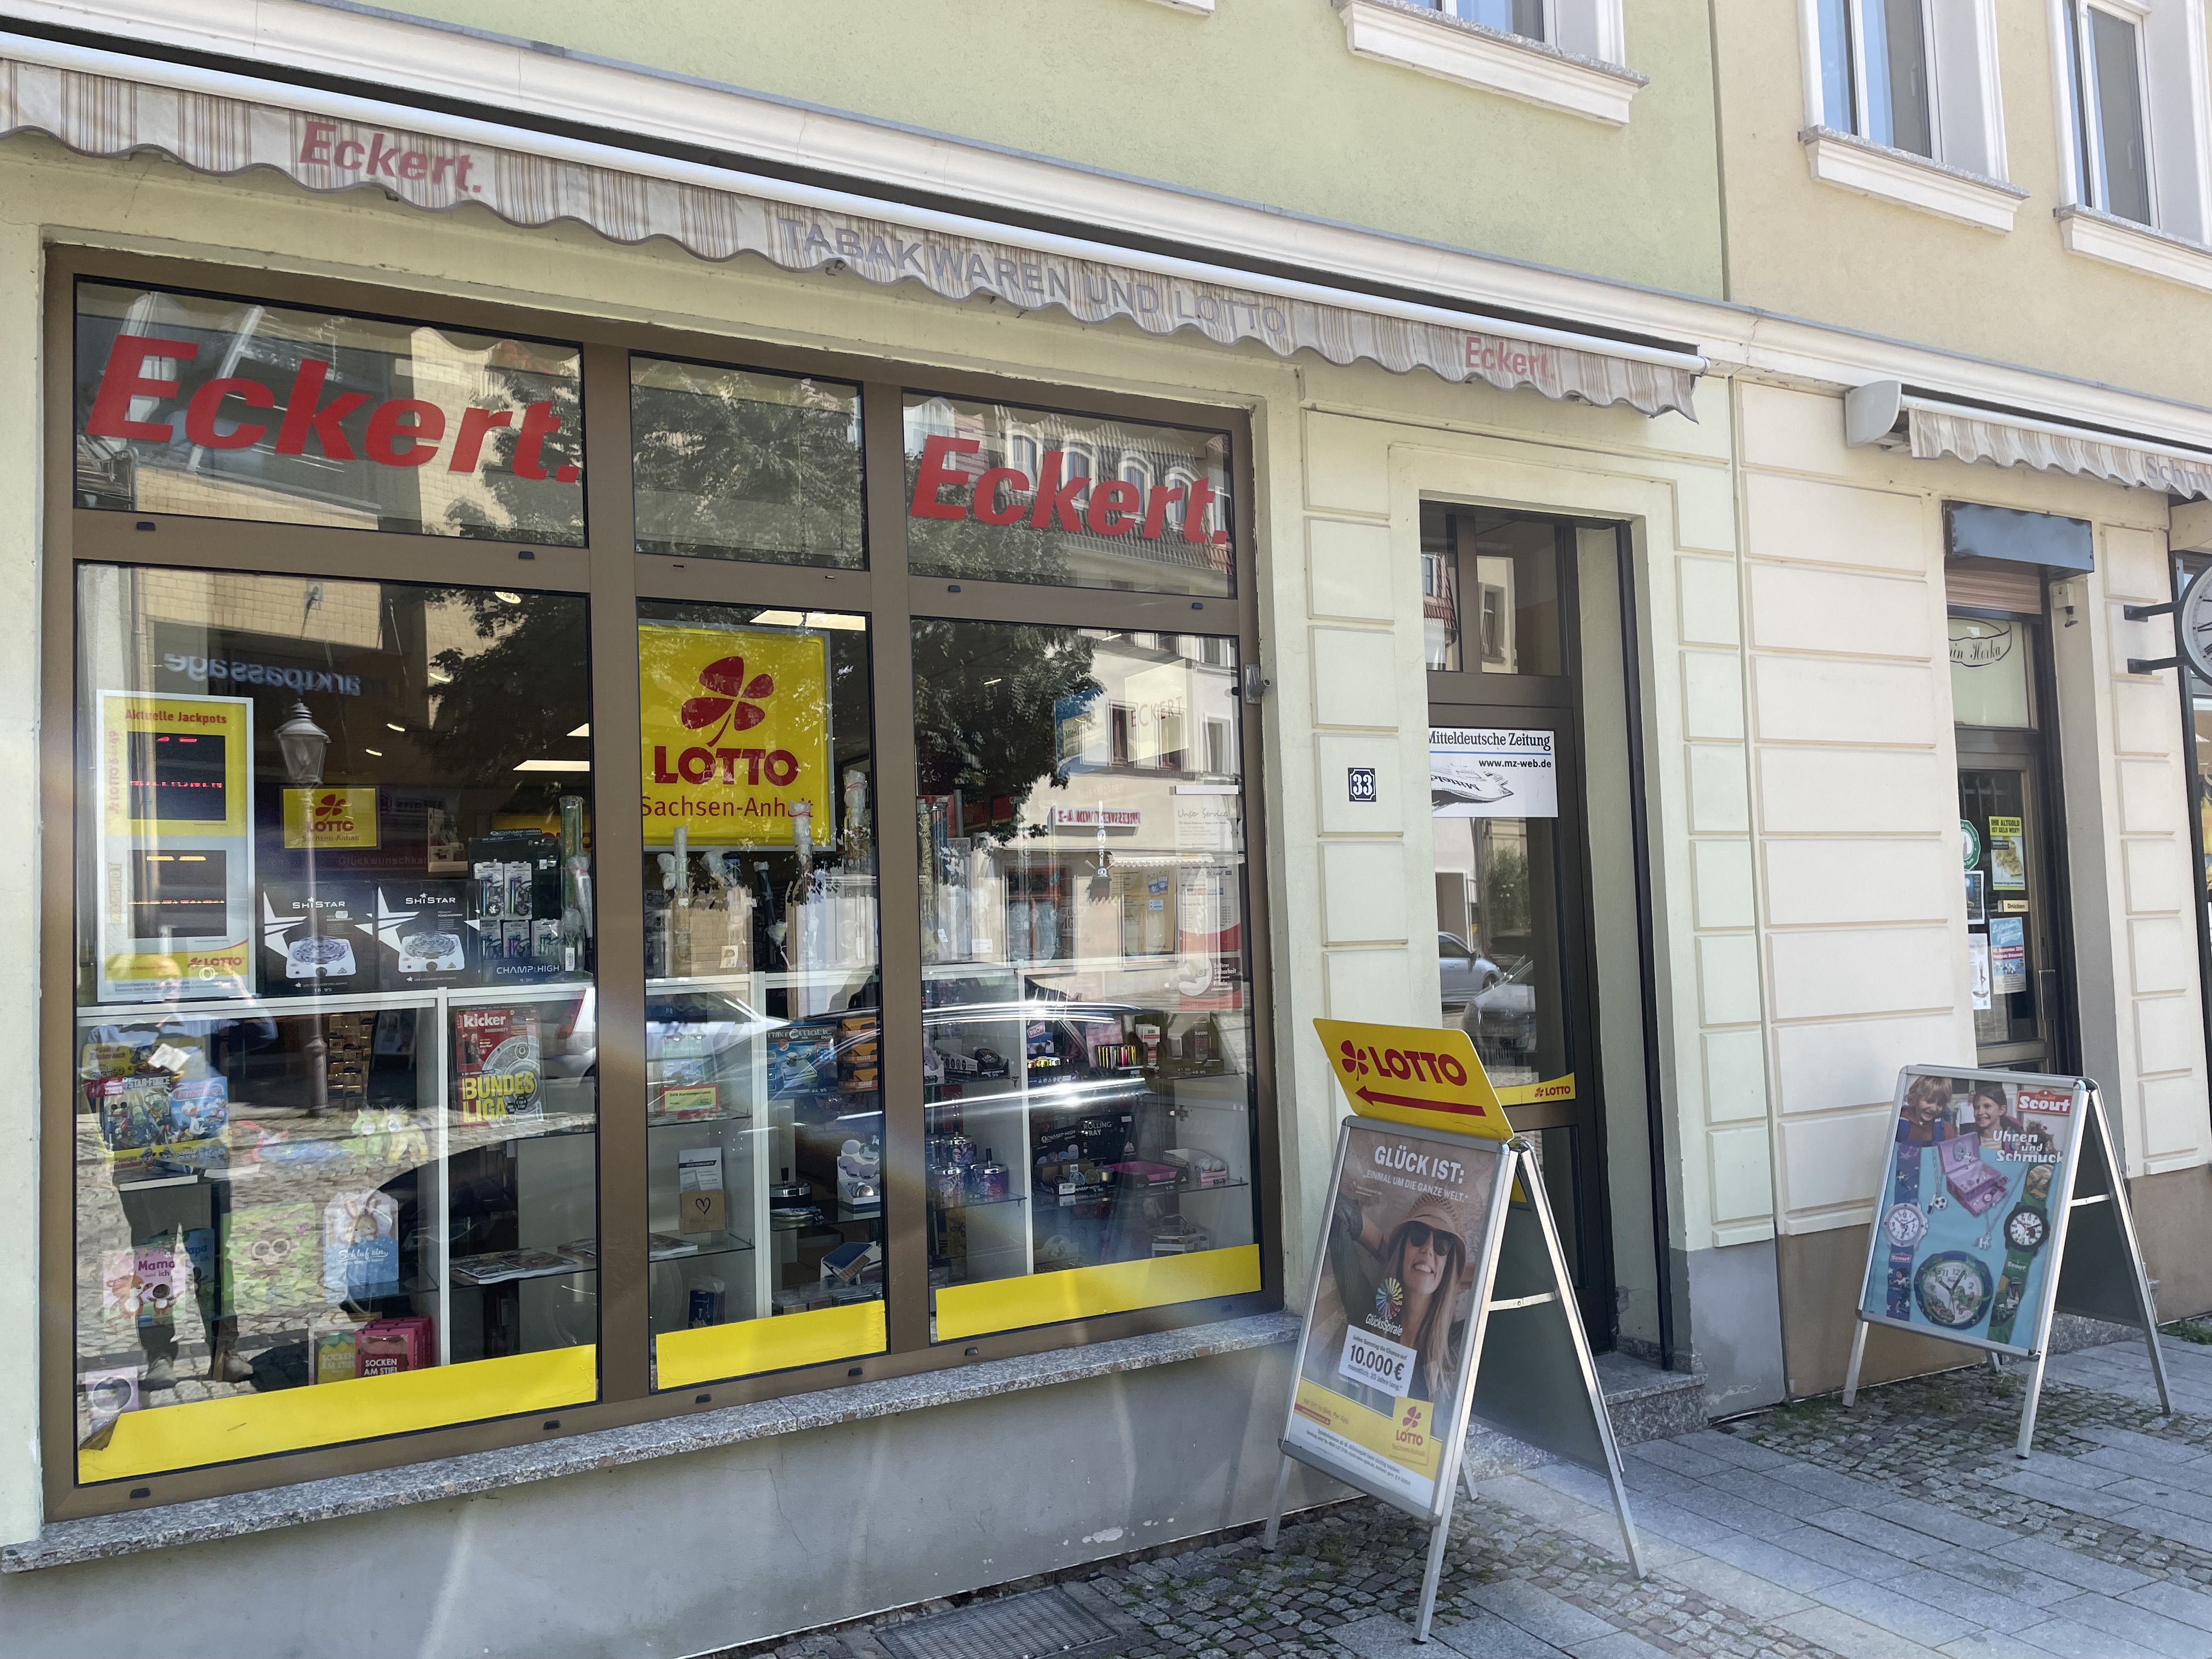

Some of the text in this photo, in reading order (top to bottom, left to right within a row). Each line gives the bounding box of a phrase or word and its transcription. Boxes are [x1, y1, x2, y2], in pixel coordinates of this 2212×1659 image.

[300, 121, 482, 193] Eckert.
[781, 219, 1285, 335] TABAKWAREN UND LOTTO
[85, 335, 579, 483] Eckert.
[910, 435, 1228, 544] Eckert.
[177, 712, 227, 725] Jackpots
[1509, 733, 1550, 751] Zeitung
[654, 746, 799, 786] LOTTO
[1479, 759, 1551, 768] www.mz-web.de
[1352, 774, 1373, 796] 33
[204, 957, 243, 967] LOTTO
[463, 1013, 506, 1028] kicker
[1368, 1046, 1468, 1086] LOTTO
[462, 1071, 535, 1101] BUNDES
[1545, 1086, 1571, 1097] LOTTO
[462, 1097, 507, 1123] LIGA
[2018, 1095, 2070, 1113] Scout
[1083, 1121, 1112, 1130] ROLLING
[1993, 1130, 2038, 1144] Uhren
[1995, 1150, 2063, 1164] Schmuck
[2022, 1143, 2042, 1153] und
[1374, 1144, 1465, 1184] GLÜCK IST:
[1392, 1176, 1404, 1187] UM
[1404, 1180, 1417, 1190] DIE
[1418, 1182, 1443, 1197] GANZE
[138, 1260, 175, 1271] Mama
[1365, 1313, 1403, 1336] GlücksSpirale
[365, 1358, 397, 1367] SOCKEN
[1350, 1344, 1405, 1381] 10.000 €
[1396, 1429, 1423, 1446] LOTTO
